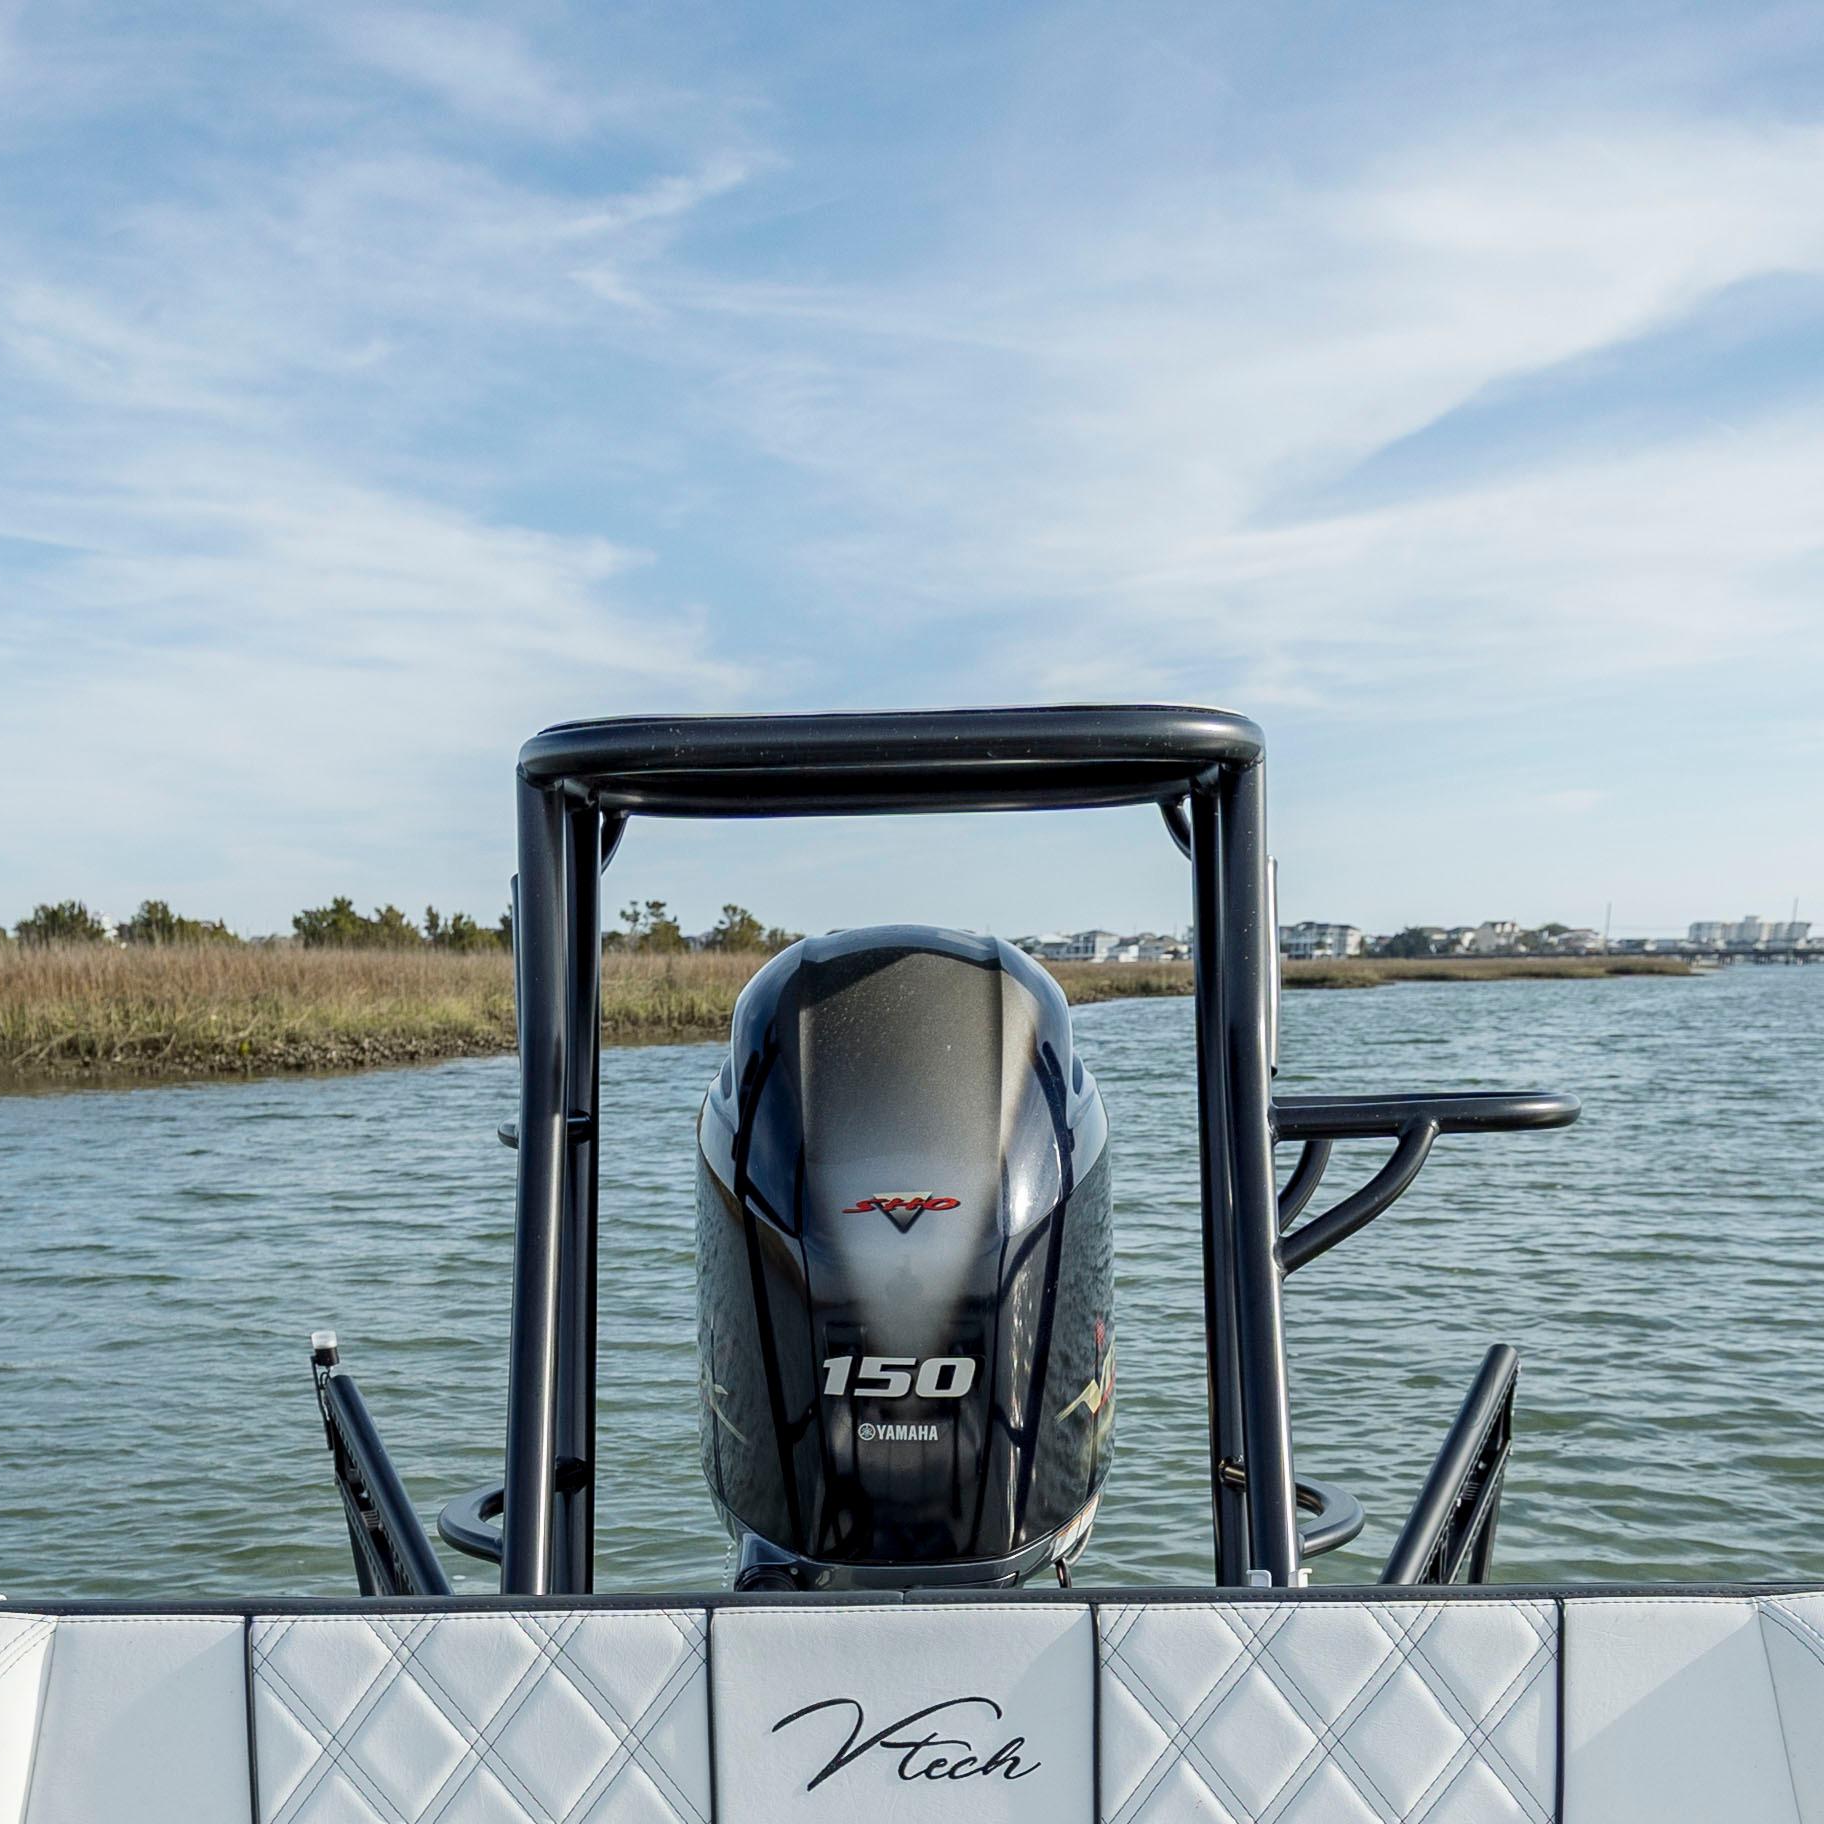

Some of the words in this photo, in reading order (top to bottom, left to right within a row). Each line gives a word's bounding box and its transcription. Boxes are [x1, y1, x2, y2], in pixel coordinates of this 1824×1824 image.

[822, 1355, 977, 1398] 150
[877, 1424, 939, 1441] YAMAHA
[771, 1696, 1042, 1793] Vtech
